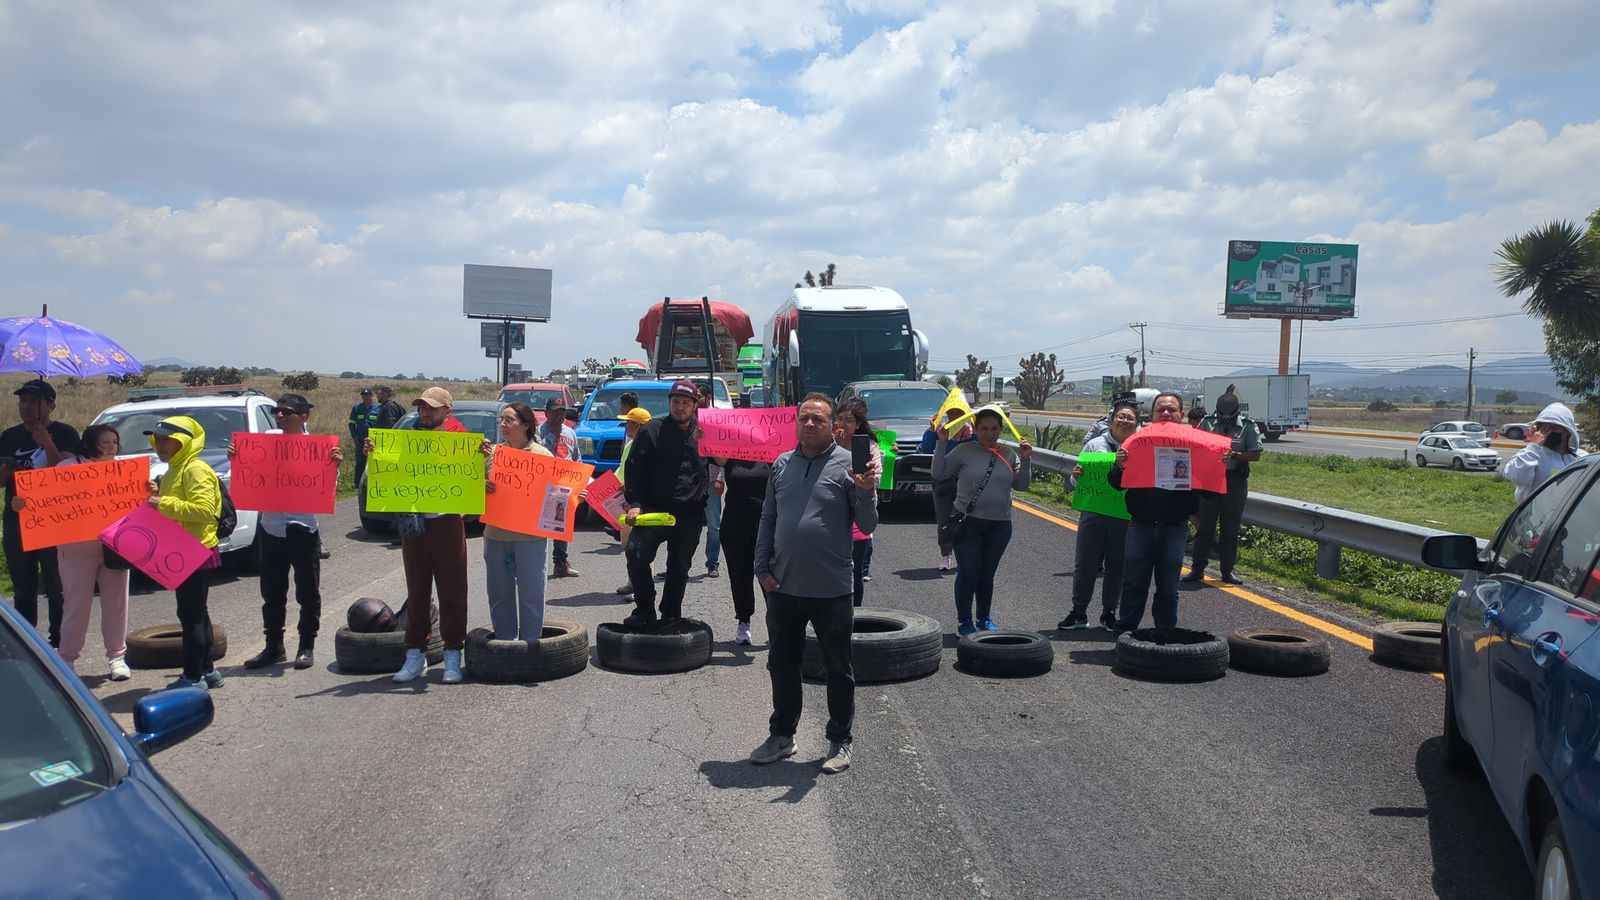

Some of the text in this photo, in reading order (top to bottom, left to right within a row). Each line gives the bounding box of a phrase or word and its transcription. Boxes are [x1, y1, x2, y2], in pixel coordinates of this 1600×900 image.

[1295, 243, 1327, 255] Casas
[703, 413, 752, 425] PEDIMOS
[407, 434, 447, 457] horas
[718, 429, 745, 440] DEL
[53, 466, 99, 482] horas
[276, 465, 325, 495] favor!
[371, 459, 479, 480] La queremos
[550, 460, 583, 482] tiempo
[24, 491, 93, 513] Queremos
[369, 481, 463, 504] de regreso
[25, 514, 46, 530] de
[99, 503, 109, 518] y
